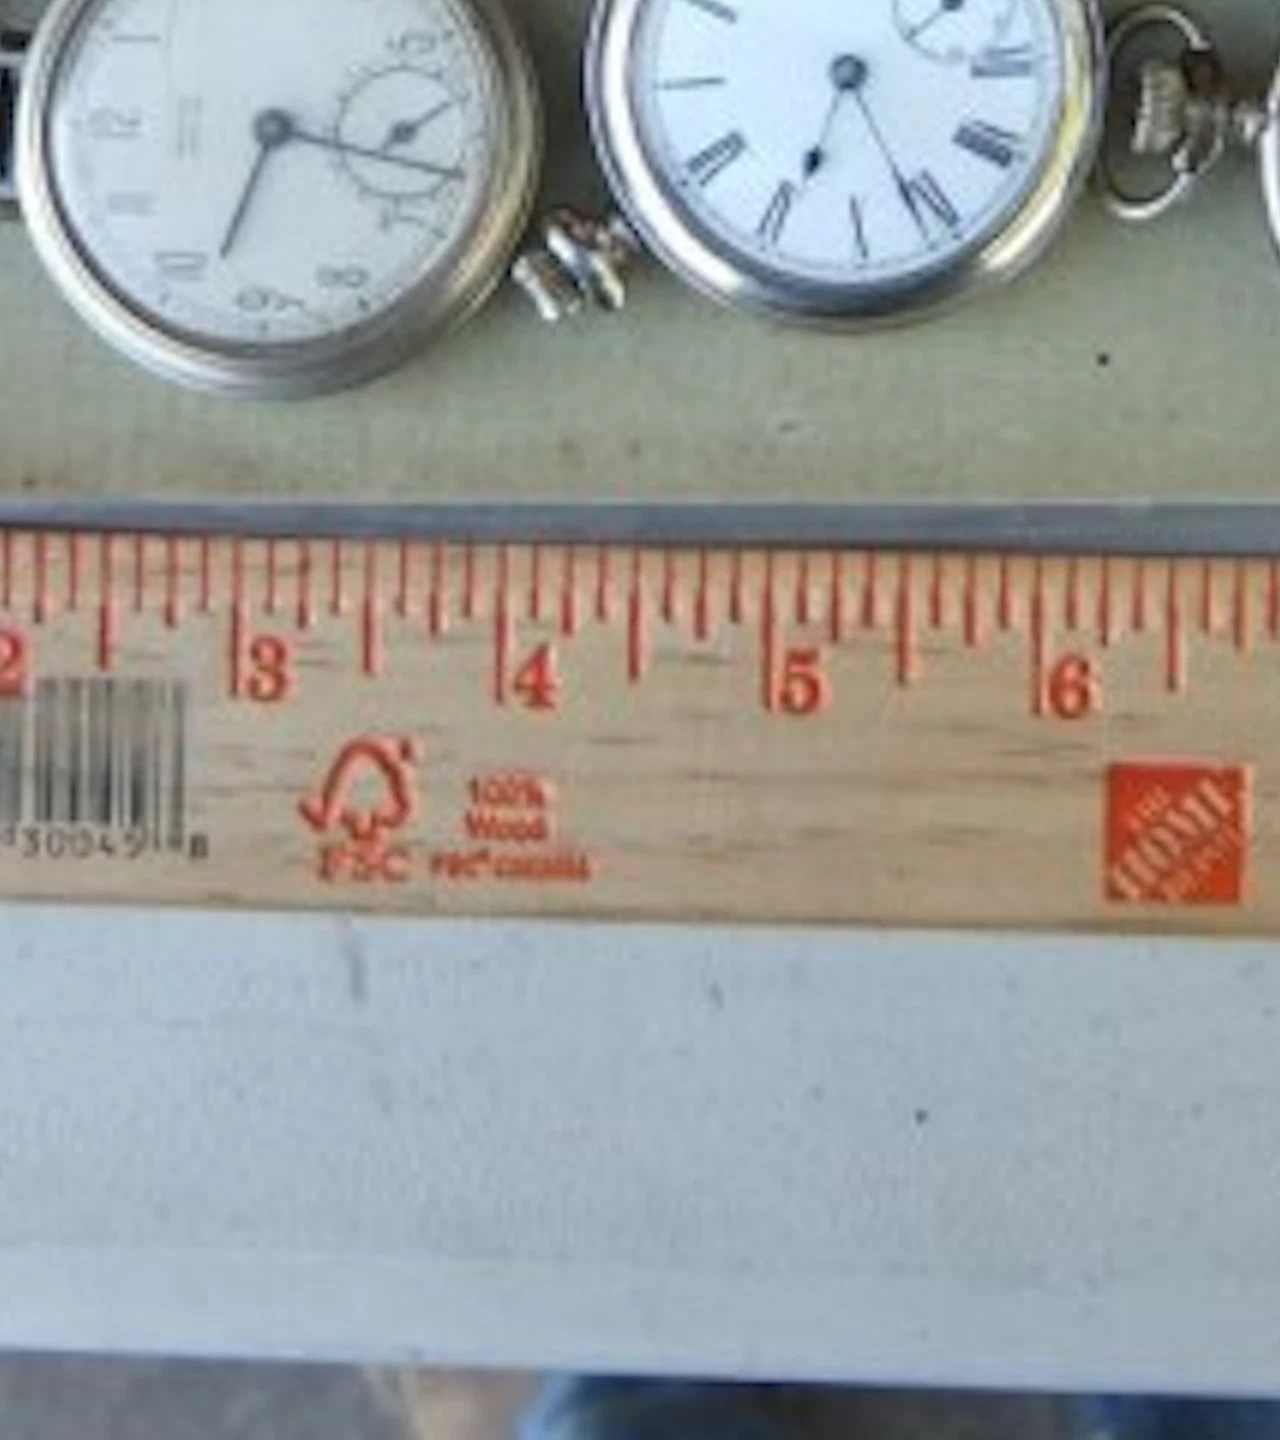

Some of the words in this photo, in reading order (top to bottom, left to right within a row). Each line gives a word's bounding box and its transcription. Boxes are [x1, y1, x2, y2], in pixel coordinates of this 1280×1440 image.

[247, 636, 292, 702] 3
[513, 642, 558, 709] 4
[777, 653, 822, 716] 5
[1047, 656, 1095, 720] 6
